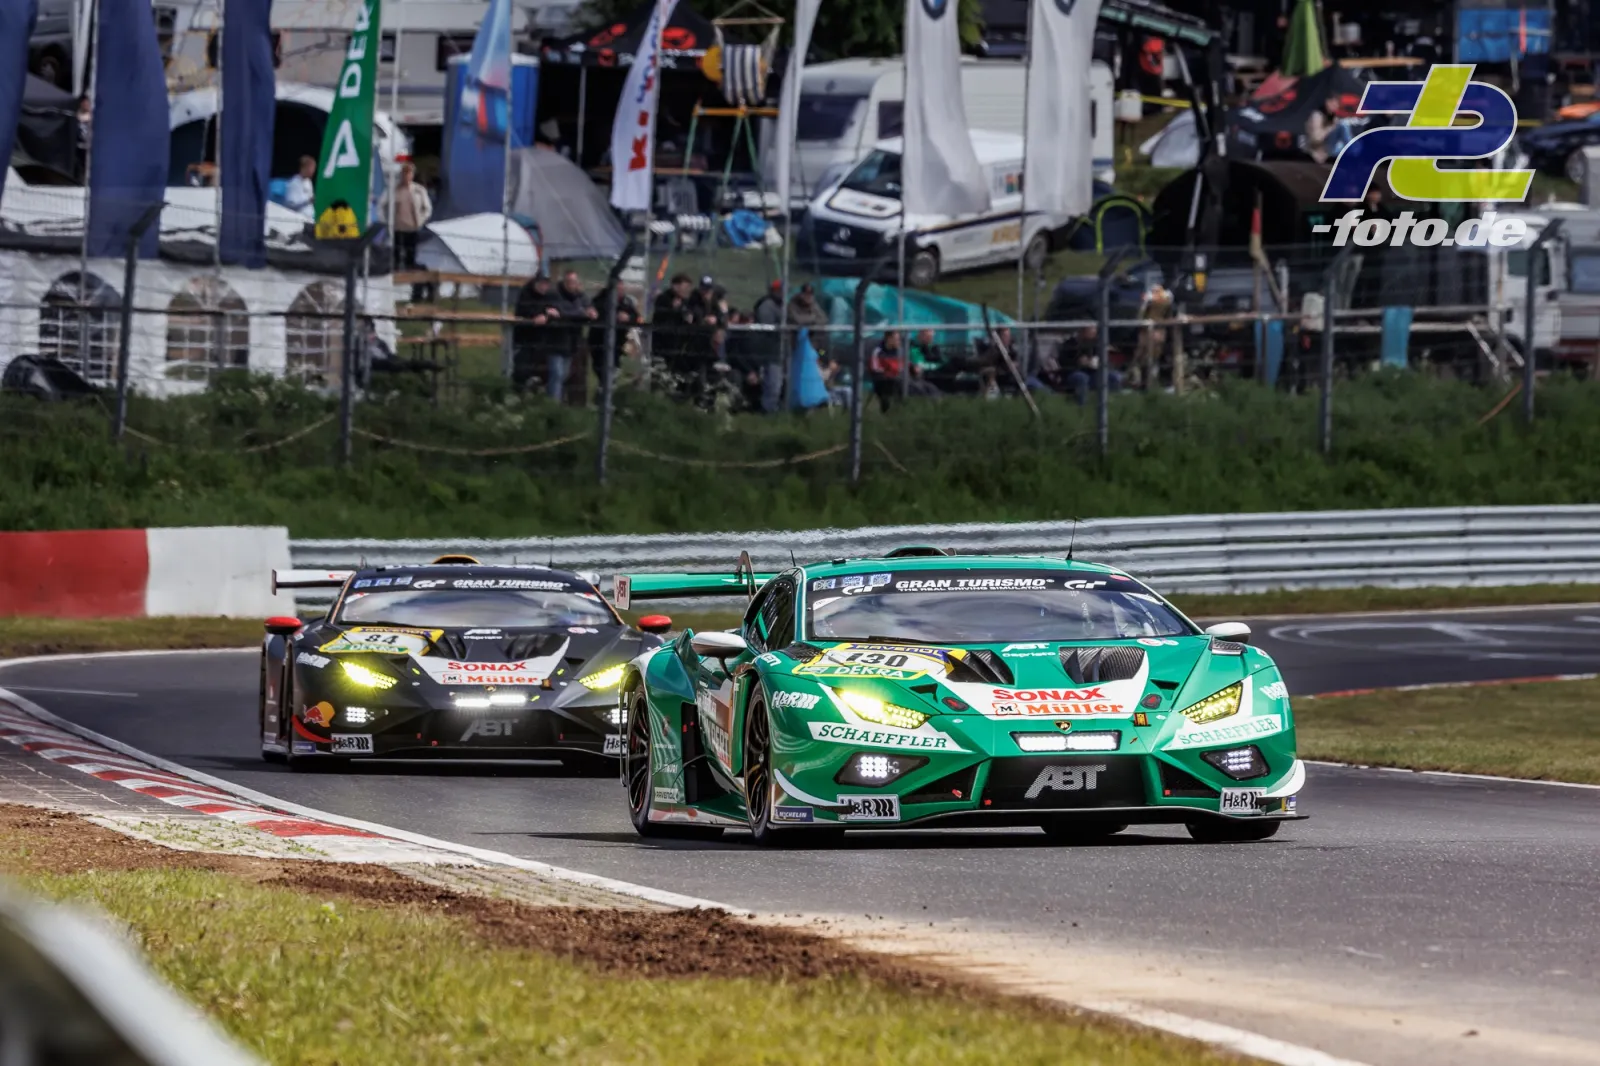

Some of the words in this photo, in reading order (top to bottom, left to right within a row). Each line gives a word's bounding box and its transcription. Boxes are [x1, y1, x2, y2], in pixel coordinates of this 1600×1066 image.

[453, 579, 495, 588] GRAN
[895, 579, 951, 589] GRAN
[956, 577, 1047, 588] TURISMO
[365, 634, 400, 644] 84
[856, 643, 945, 657] RAVENOL
[448, 661, 528, 672] SONAX
[846, 652, 909, 668] 130
[834, 664, 904, 679] DEKRA
[467, 675, 538, 684] Müller
[992, 687, 1106, 702] SONAX
[1026, 702, 1124, 715] Müller
[459, 718, 519, 742] ABT
[818, 724, 948, 749] SCHAEFFLER
[1178, 717, 1278, 745] SCHAEFFLER
[1024, 764, 1107, 799] ABT
[1223, 792, 1248, 809] H&R
